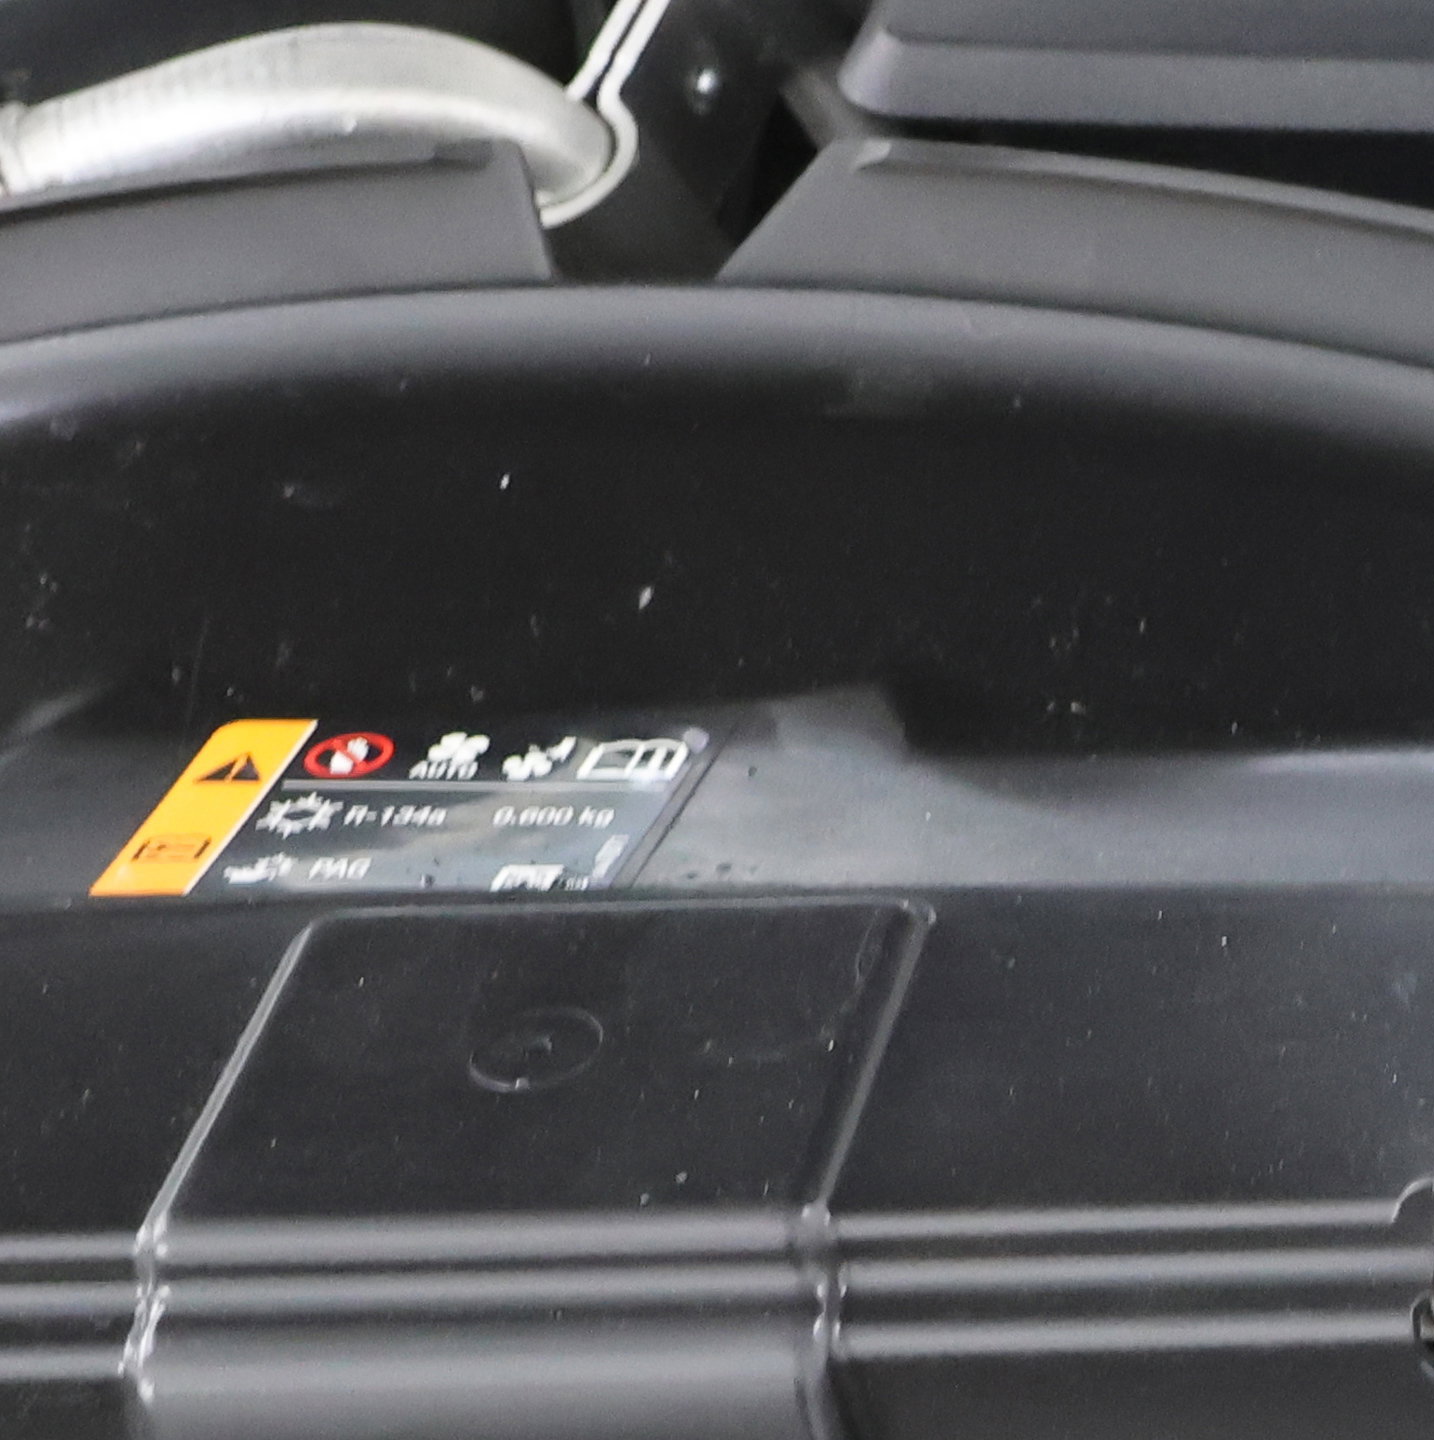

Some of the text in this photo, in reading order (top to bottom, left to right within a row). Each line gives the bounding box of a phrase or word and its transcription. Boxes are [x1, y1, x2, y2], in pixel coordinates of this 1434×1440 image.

[408, 759, 479, 780] AUTO
[343, 804, 447, 826] R-134a
[578, 806, 615, 830] kg
[308, 856, 373, 880] PAG
